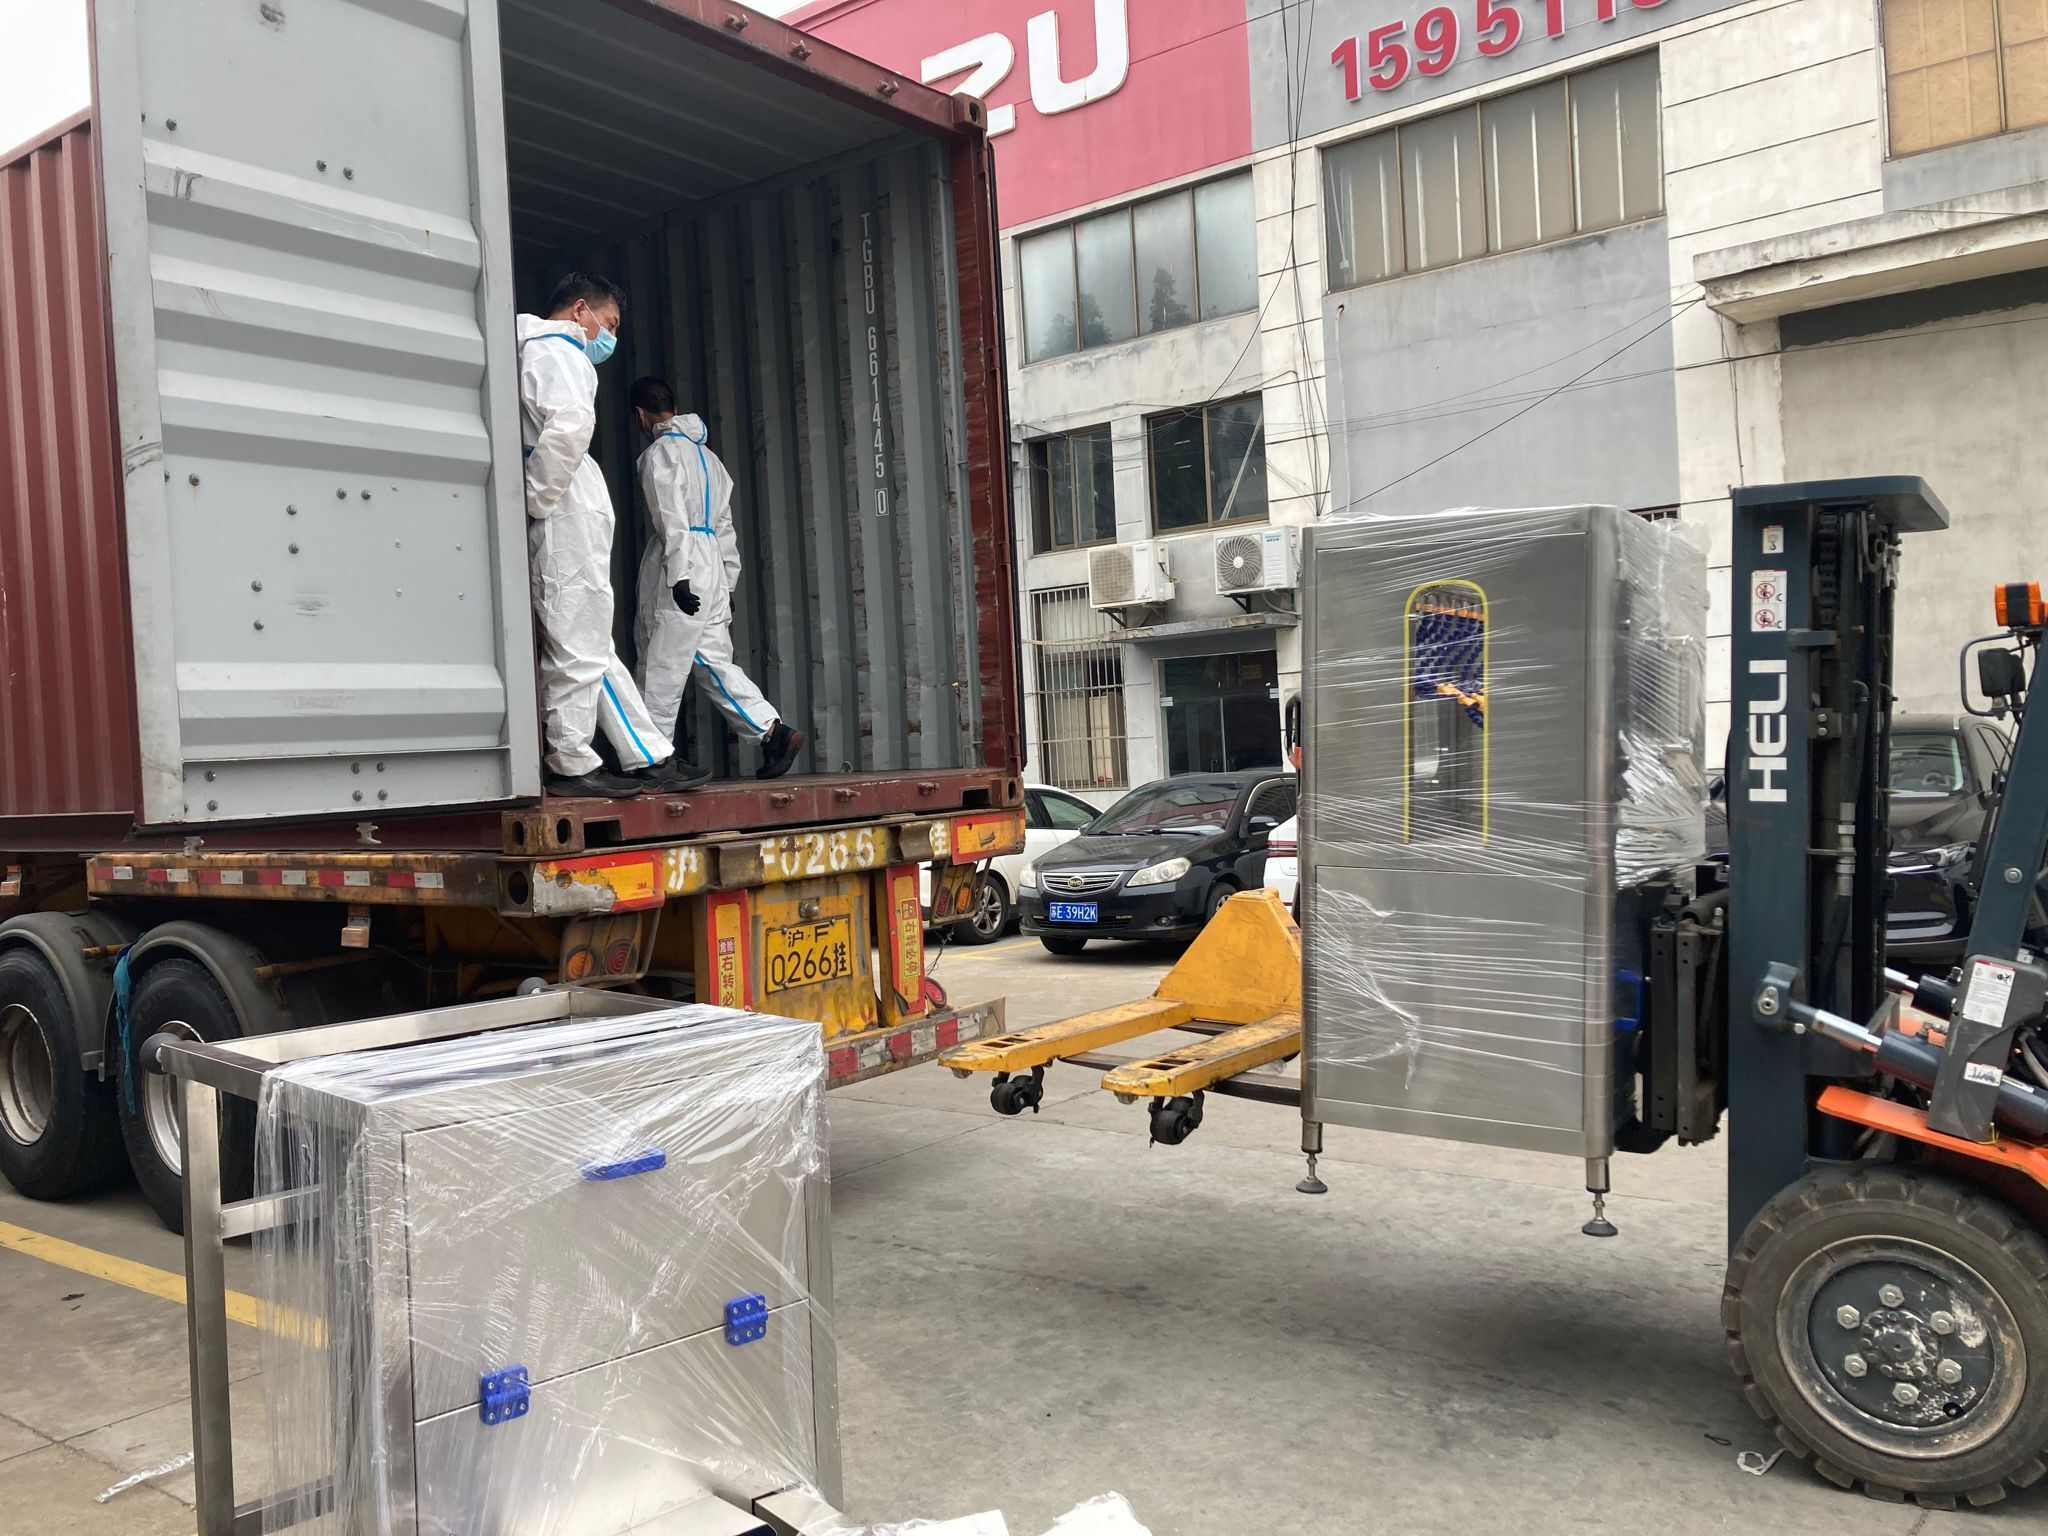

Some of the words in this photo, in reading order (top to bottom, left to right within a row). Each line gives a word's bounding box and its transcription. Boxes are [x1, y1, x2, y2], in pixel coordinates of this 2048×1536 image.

[896, 0, 1129, 137] ZU
[1330, 7, 1461, 102] 159
[1476, 0, 1671, 58] 51
[860, 212, 875, 314] TGBU
[867, 326, 885, 478] 661445
[1748, 659, 1787, 802] HELI
[772, 941, 848, 986] 0266挂
